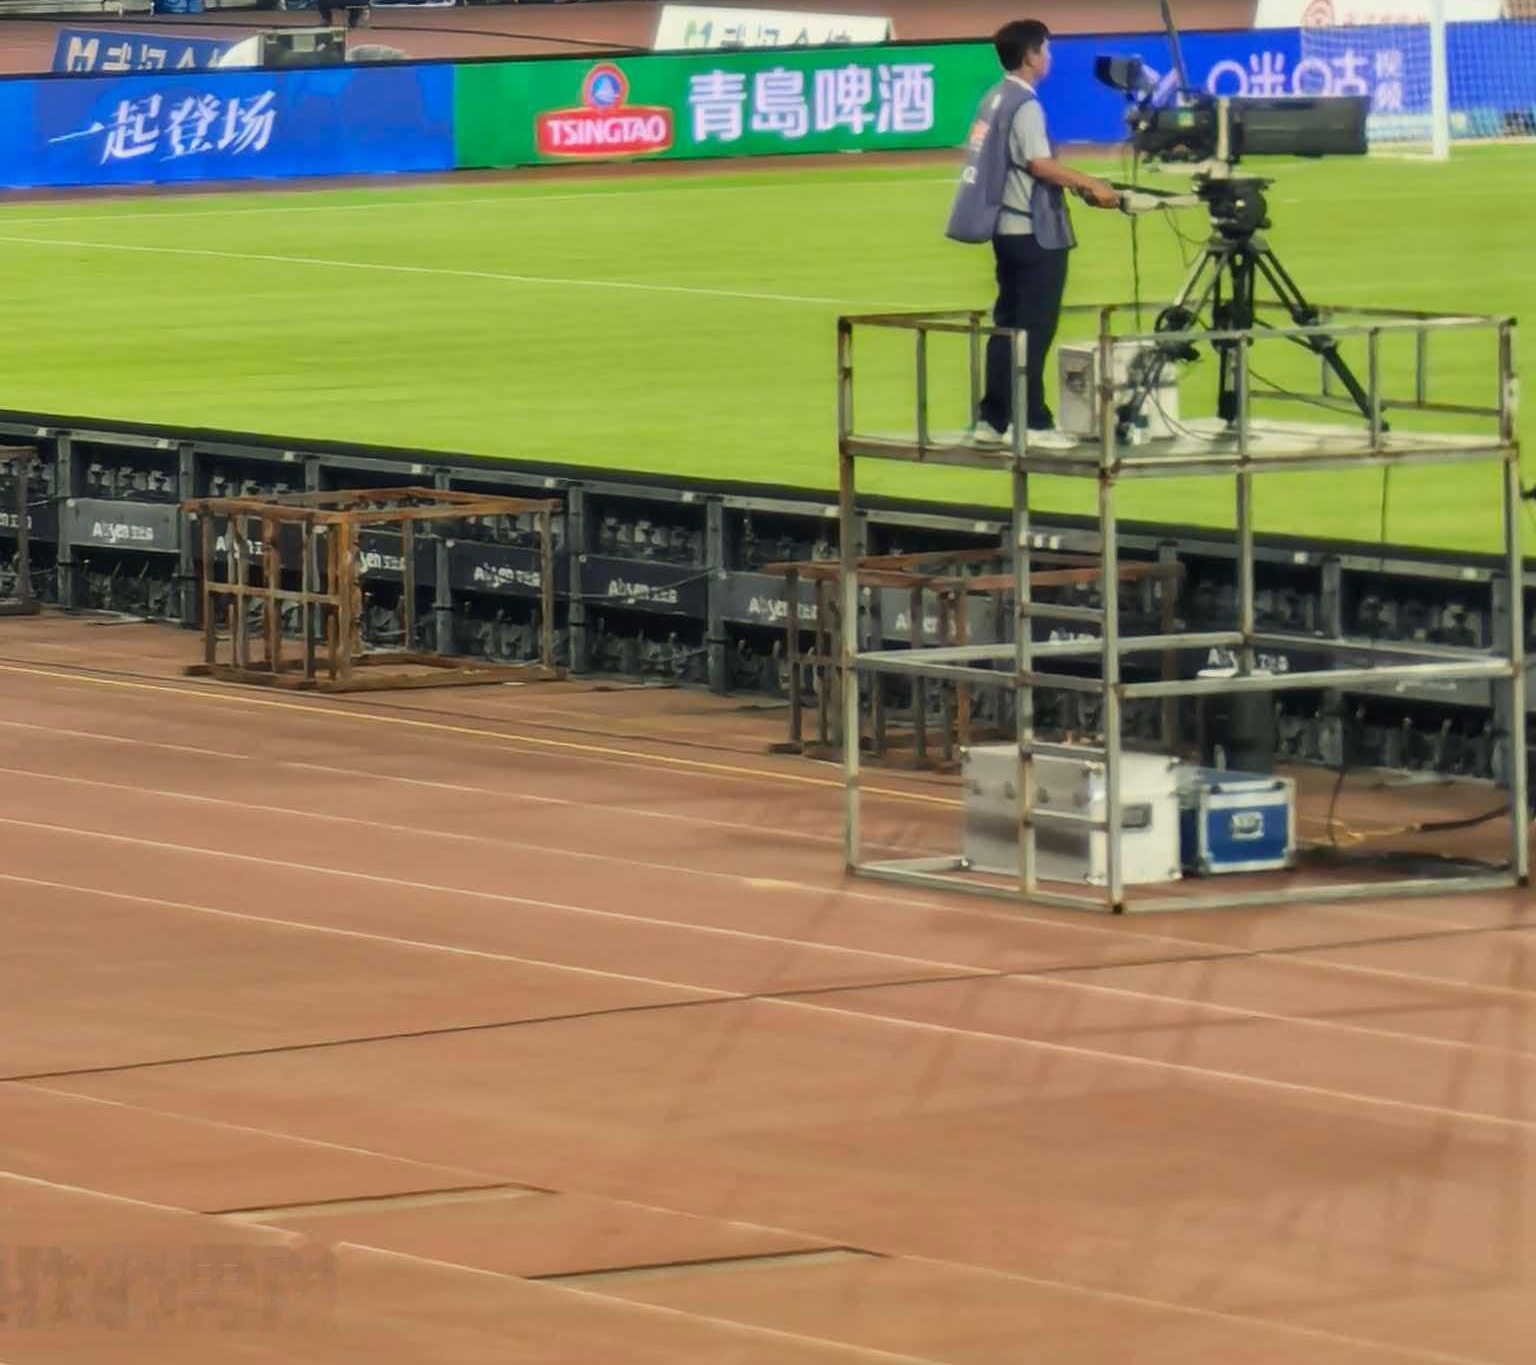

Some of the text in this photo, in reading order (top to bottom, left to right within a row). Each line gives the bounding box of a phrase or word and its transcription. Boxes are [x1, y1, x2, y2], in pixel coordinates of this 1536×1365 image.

[48, 89, 276, 164] 一起登场
[547, 114, 667, 147] TSINGTAO
